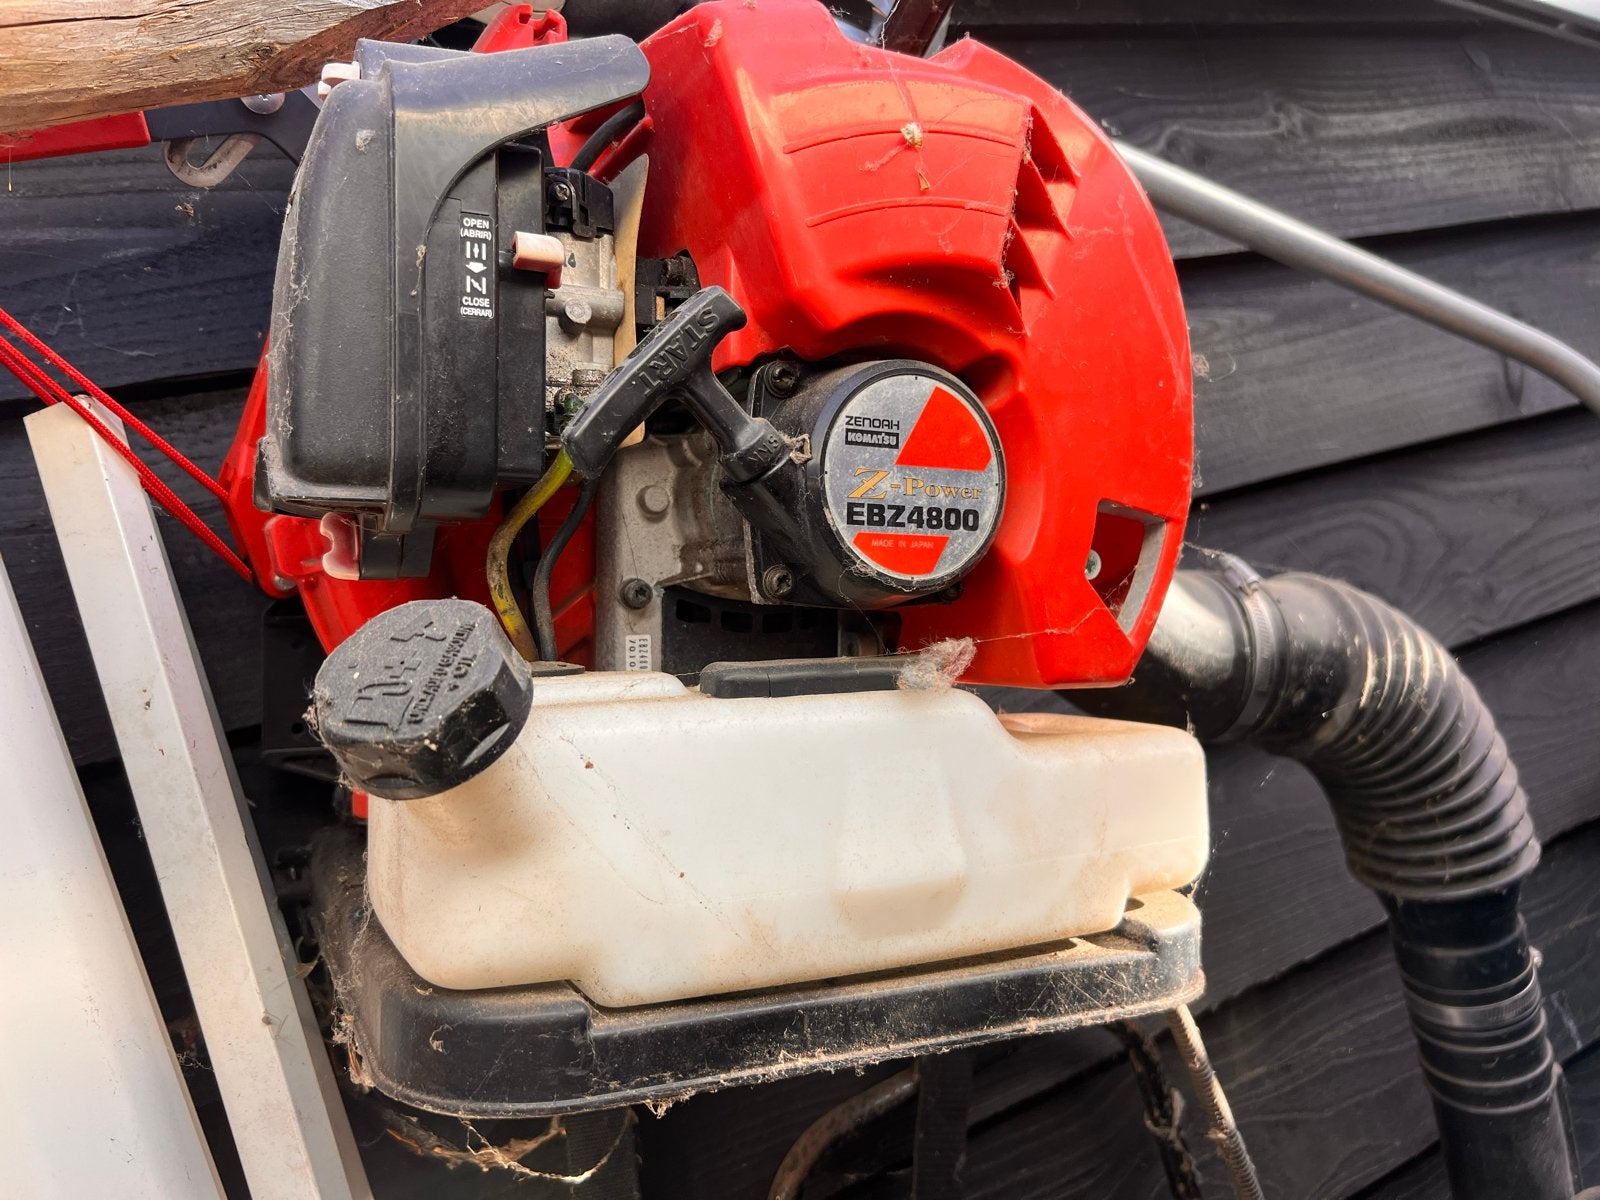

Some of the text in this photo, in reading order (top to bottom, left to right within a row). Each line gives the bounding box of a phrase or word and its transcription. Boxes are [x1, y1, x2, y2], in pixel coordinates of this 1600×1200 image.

[463, 217, 490, 229] OPEN
[460, 227, 492, 241] (ABRIR)
[462, 296, 490, 308] CLOSE
[460, 306, 493, 318] (CERRAR)
[638, 304, 720, 397] START
[845, 415, 900, 430] ZENOAH
[847, 431, 897, 446] KOMATSU
[847, 467, 983, 500] Z-Power
[846, 501, 980, 532] EBZ4800
[871, 539, 934, 549] MADE IN JAPAN
